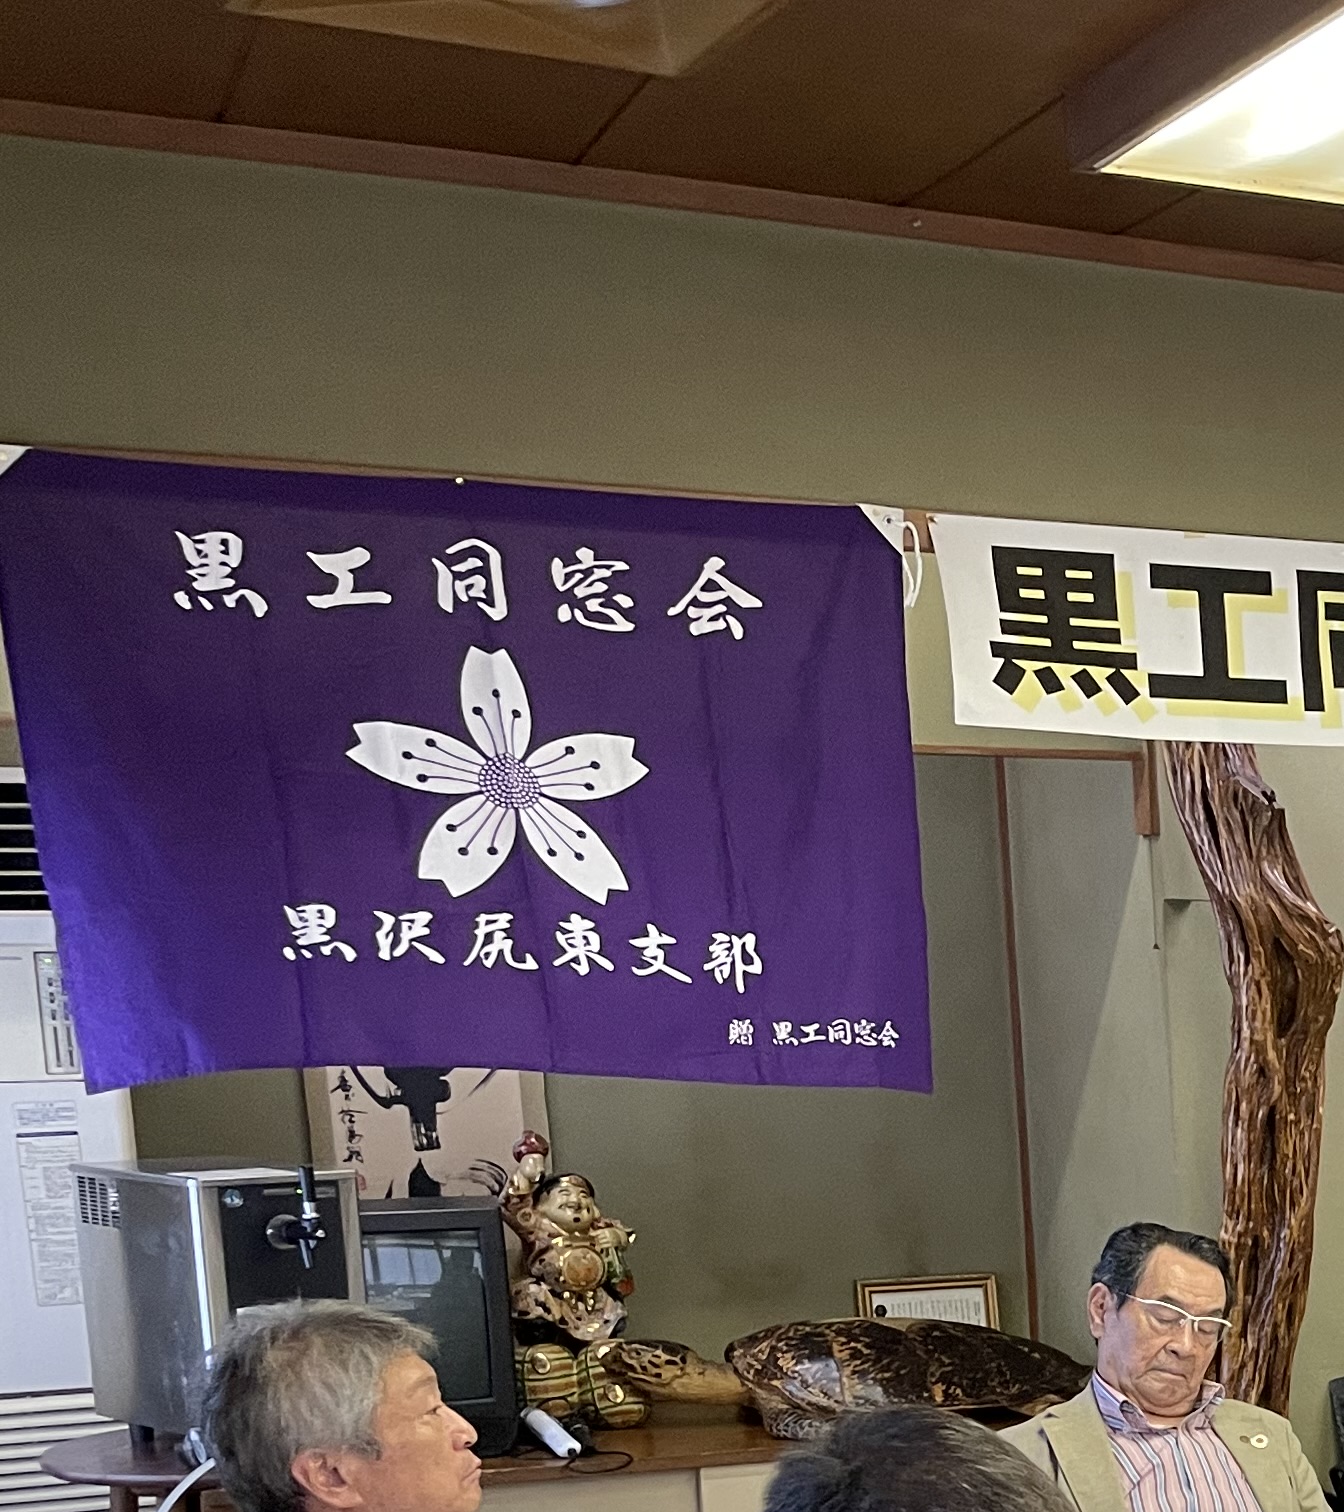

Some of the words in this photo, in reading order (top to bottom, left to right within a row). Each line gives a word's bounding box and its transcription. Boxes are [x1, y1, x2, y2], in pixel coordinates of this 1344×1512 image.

[173, 531, 763, 640] 黒工同窓会
[281, 904, 764, 994] 黒沢尻東支部
[728, 1018, 755, 1046] 贈
[772, 1018, 900, 1048] 黒工同窓会
